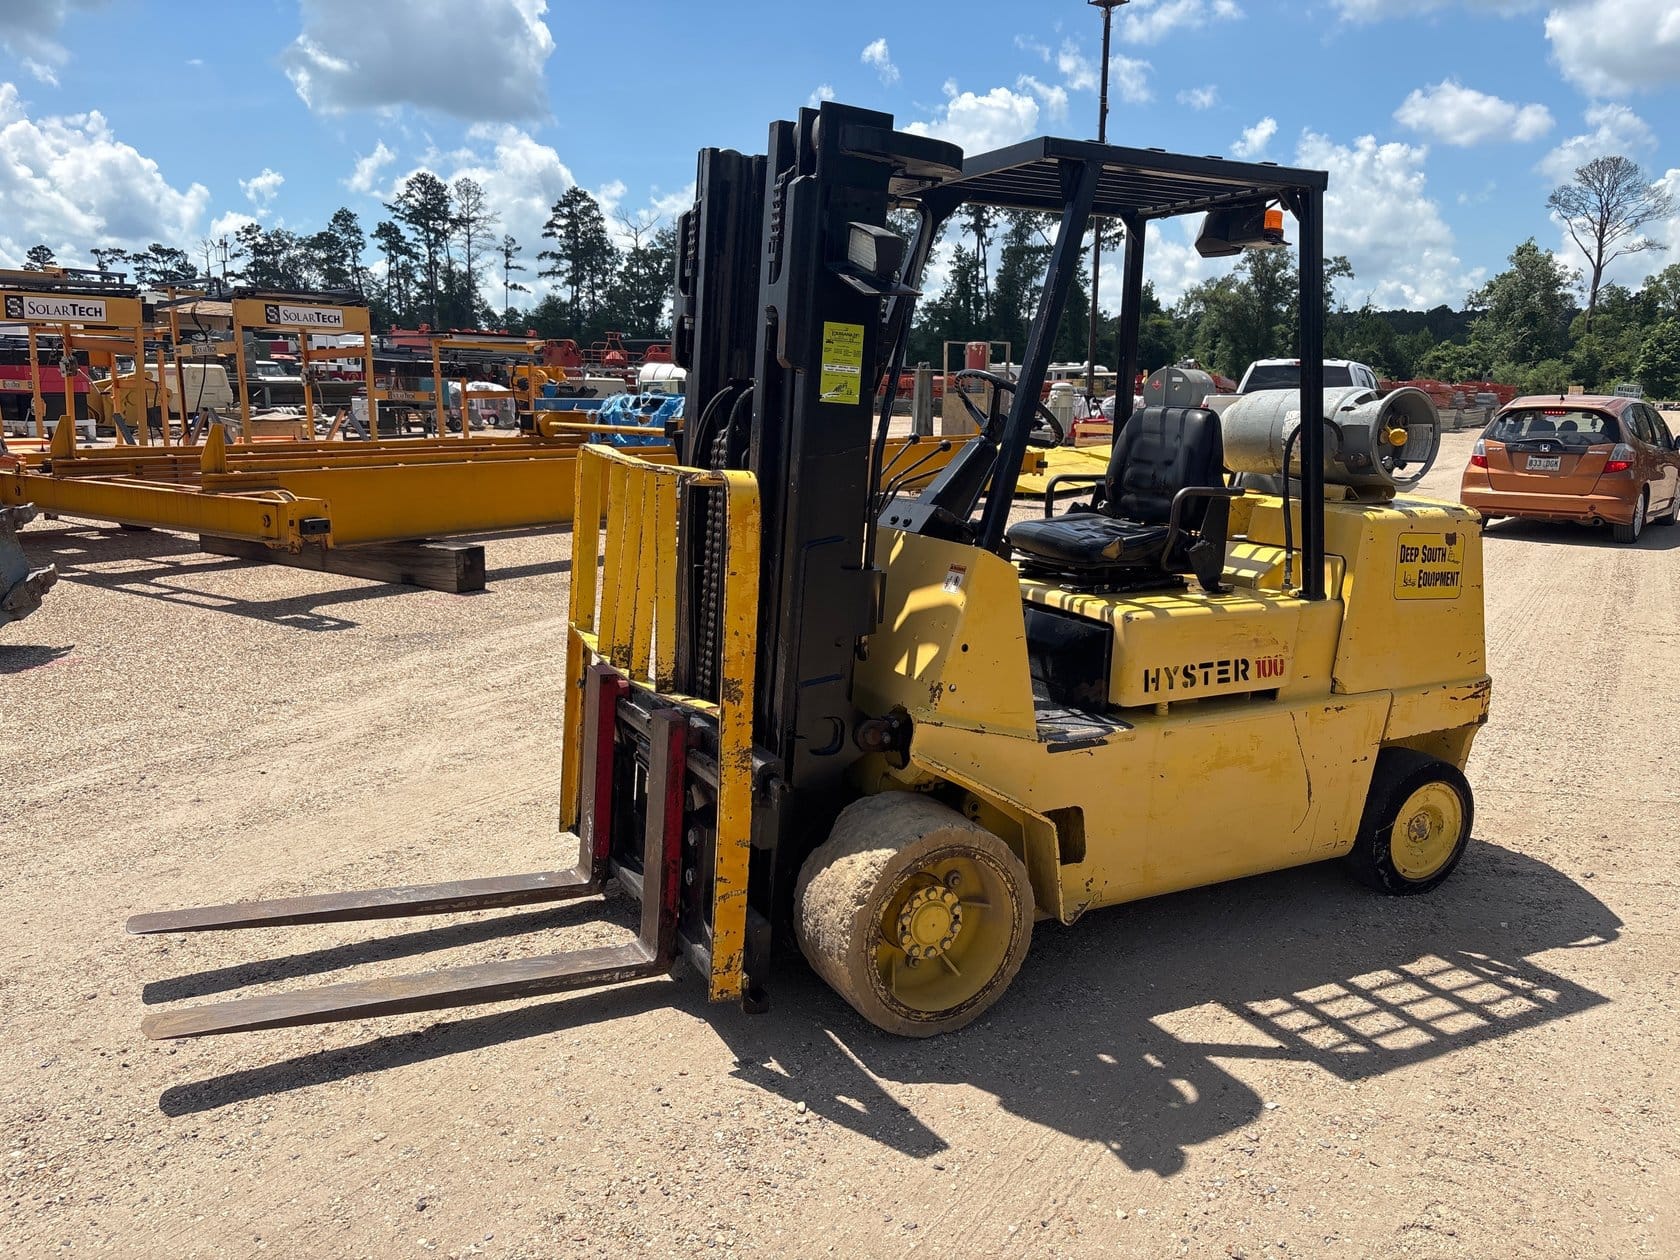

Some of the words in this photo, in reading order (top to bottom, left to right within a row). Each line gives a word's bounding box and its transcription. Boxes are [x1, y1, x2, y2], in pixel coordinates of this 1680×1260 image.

[28, 301, 103, 317] SOLARTECH
[282, 309, 341, 324] SOLARTECH
[1400, 544, 1419, 564] DEEP
[1421, 545, 1447, 564] SOUTH
[1417, 569, 1460, 588] EQUIPMENT
[1144, 658, 1250, 692] HYSTER
[1254, 654, 1285, 679] 100
